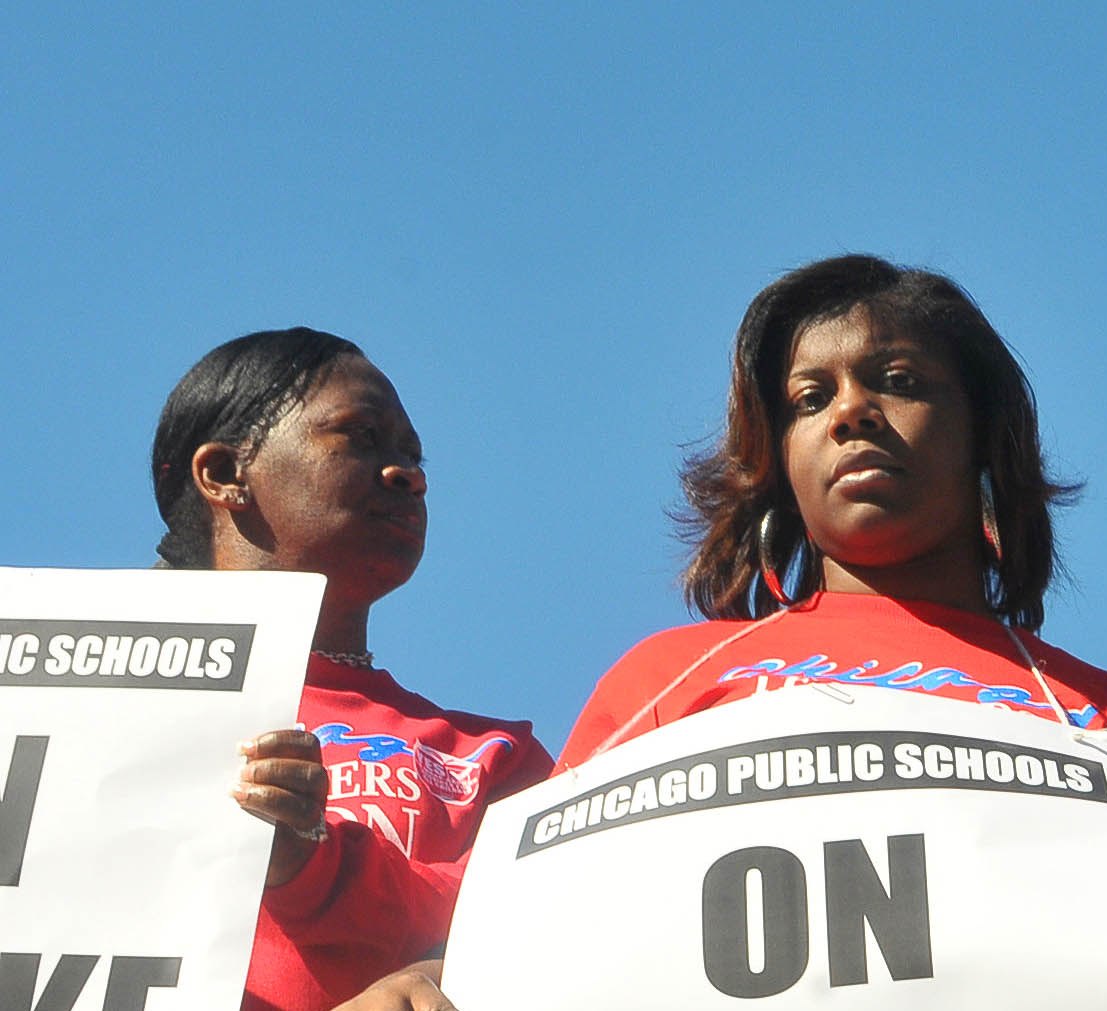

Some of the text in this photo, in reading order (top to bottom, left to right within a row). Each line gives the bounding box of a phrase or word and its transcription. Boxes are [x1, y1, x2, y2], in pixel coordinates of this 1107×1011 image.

[44, 634, 236, 680] SCHOOLS
[533, 743, 1094, 845] CHICAGO PUBLIC SCHOOLS
[702, 833, 934, 1000] ON
